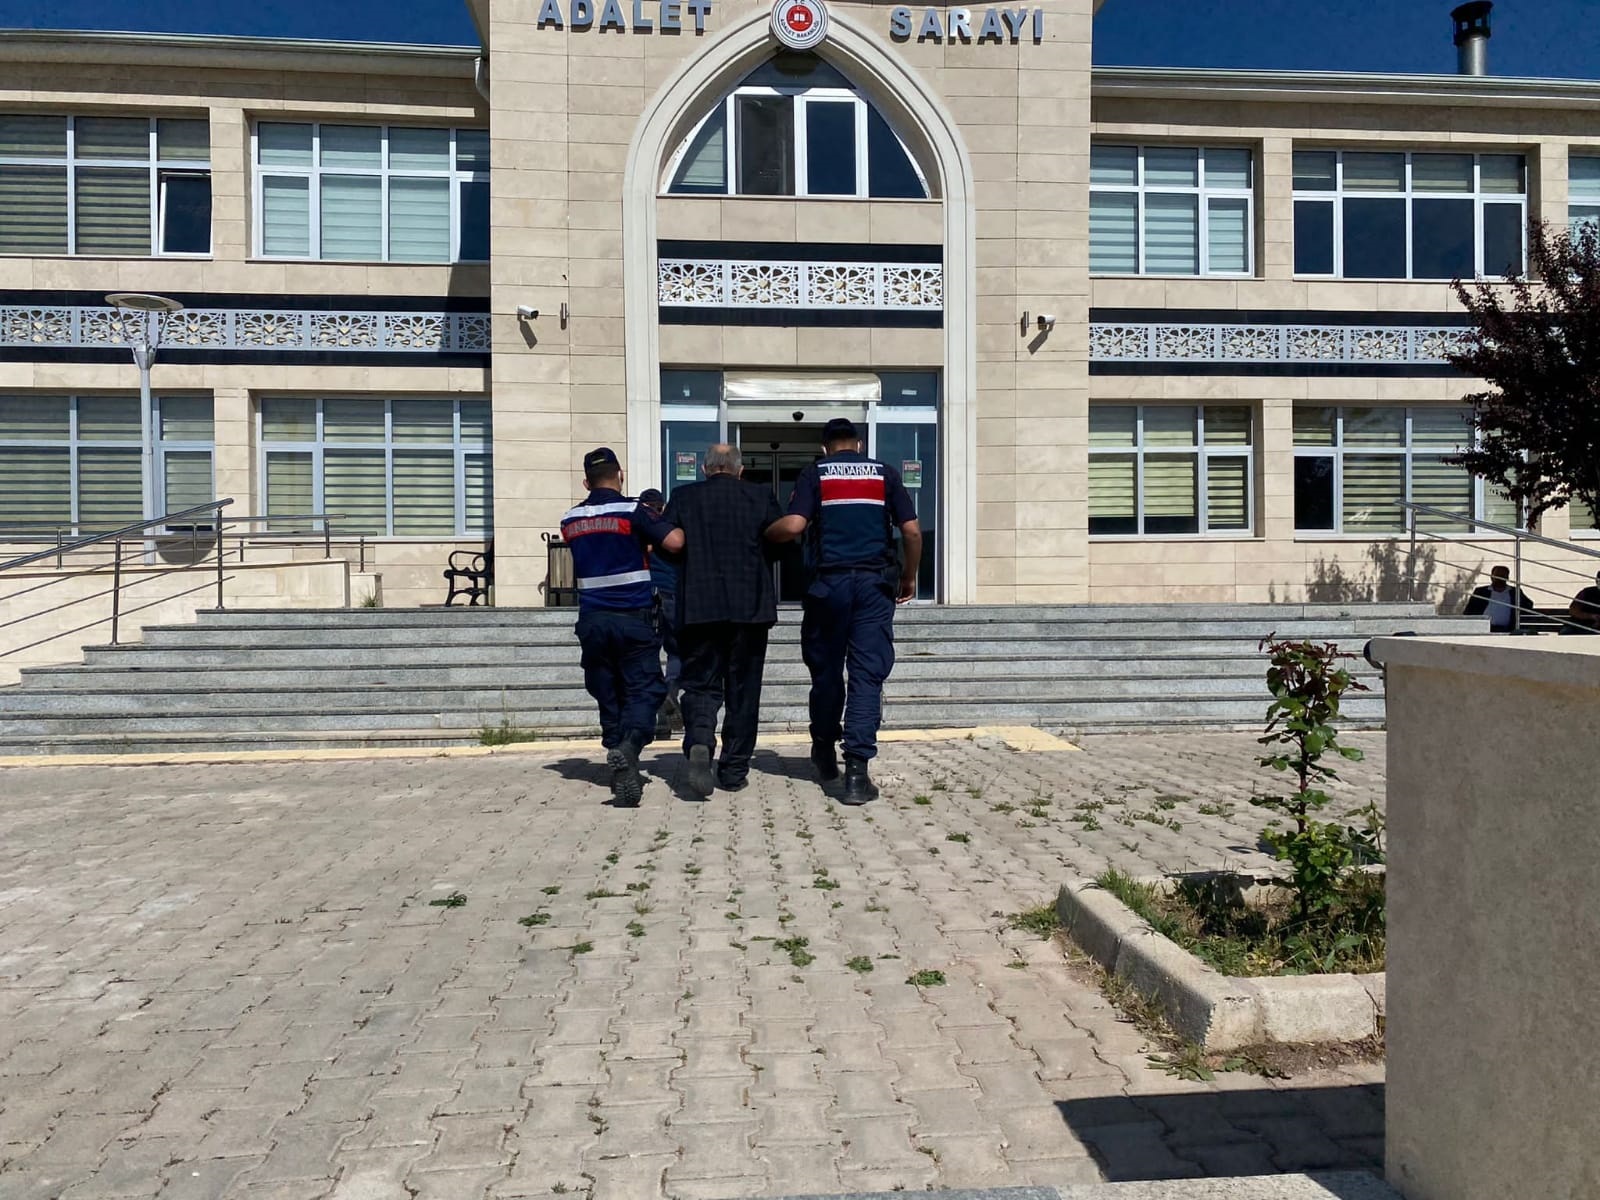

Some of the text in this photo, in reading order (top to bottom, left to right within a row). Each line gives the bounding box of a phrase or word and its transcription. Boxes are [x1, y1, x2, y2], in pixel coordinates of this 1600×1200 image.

[537, 0, 711, 35] ADALET
[889, 6, 1044, 44] SARAYI
[824, 464, 878, 477] JANDARMA
